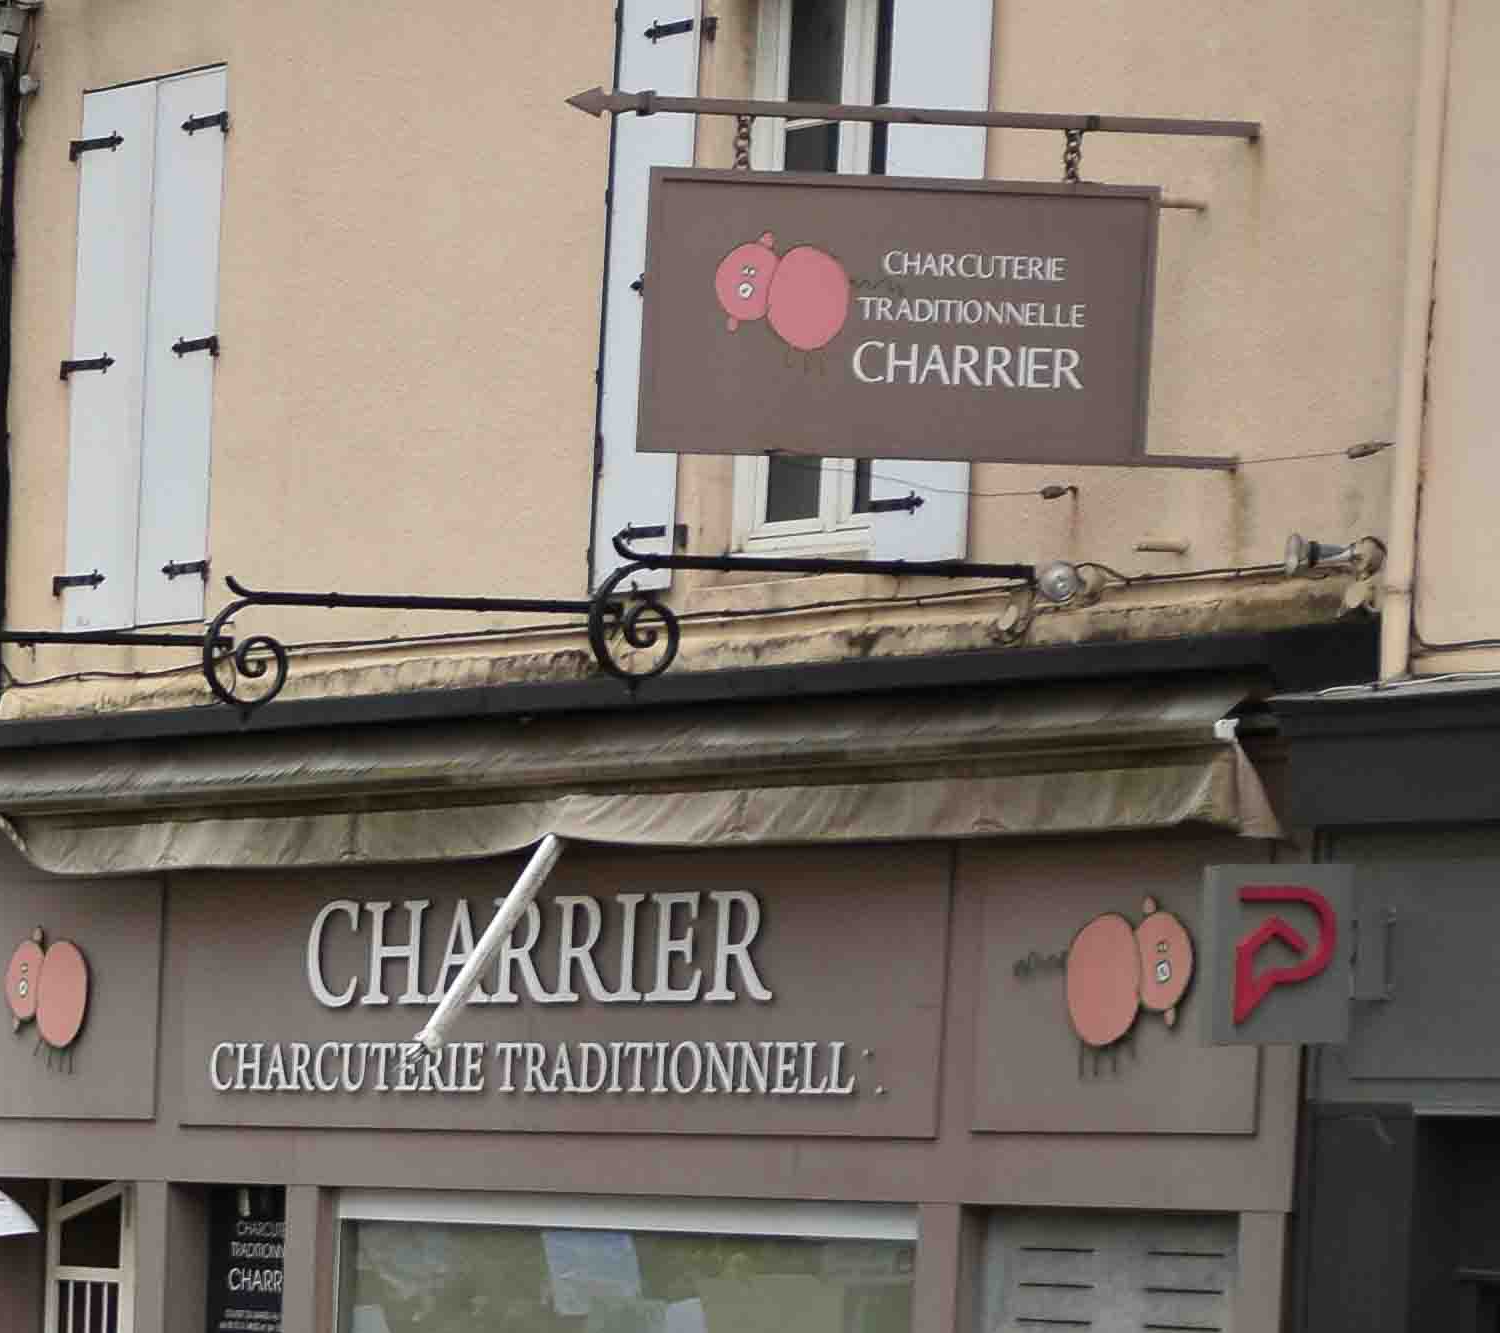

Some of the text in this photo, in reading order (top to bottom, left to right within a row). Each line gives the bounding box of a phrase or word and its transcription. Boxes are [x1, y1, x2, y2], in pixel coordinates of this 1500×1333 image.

[882, 250, 1067, 281] CHARCUTERIE
[857, 296, 1085, 328] TRADITIONNELLE
[853, 340, 1084, 390] CHARRIER
[307, 888, 773, 1007] CHARRIER
[209, 1039, 486, 1092] CHARCUTERIE
